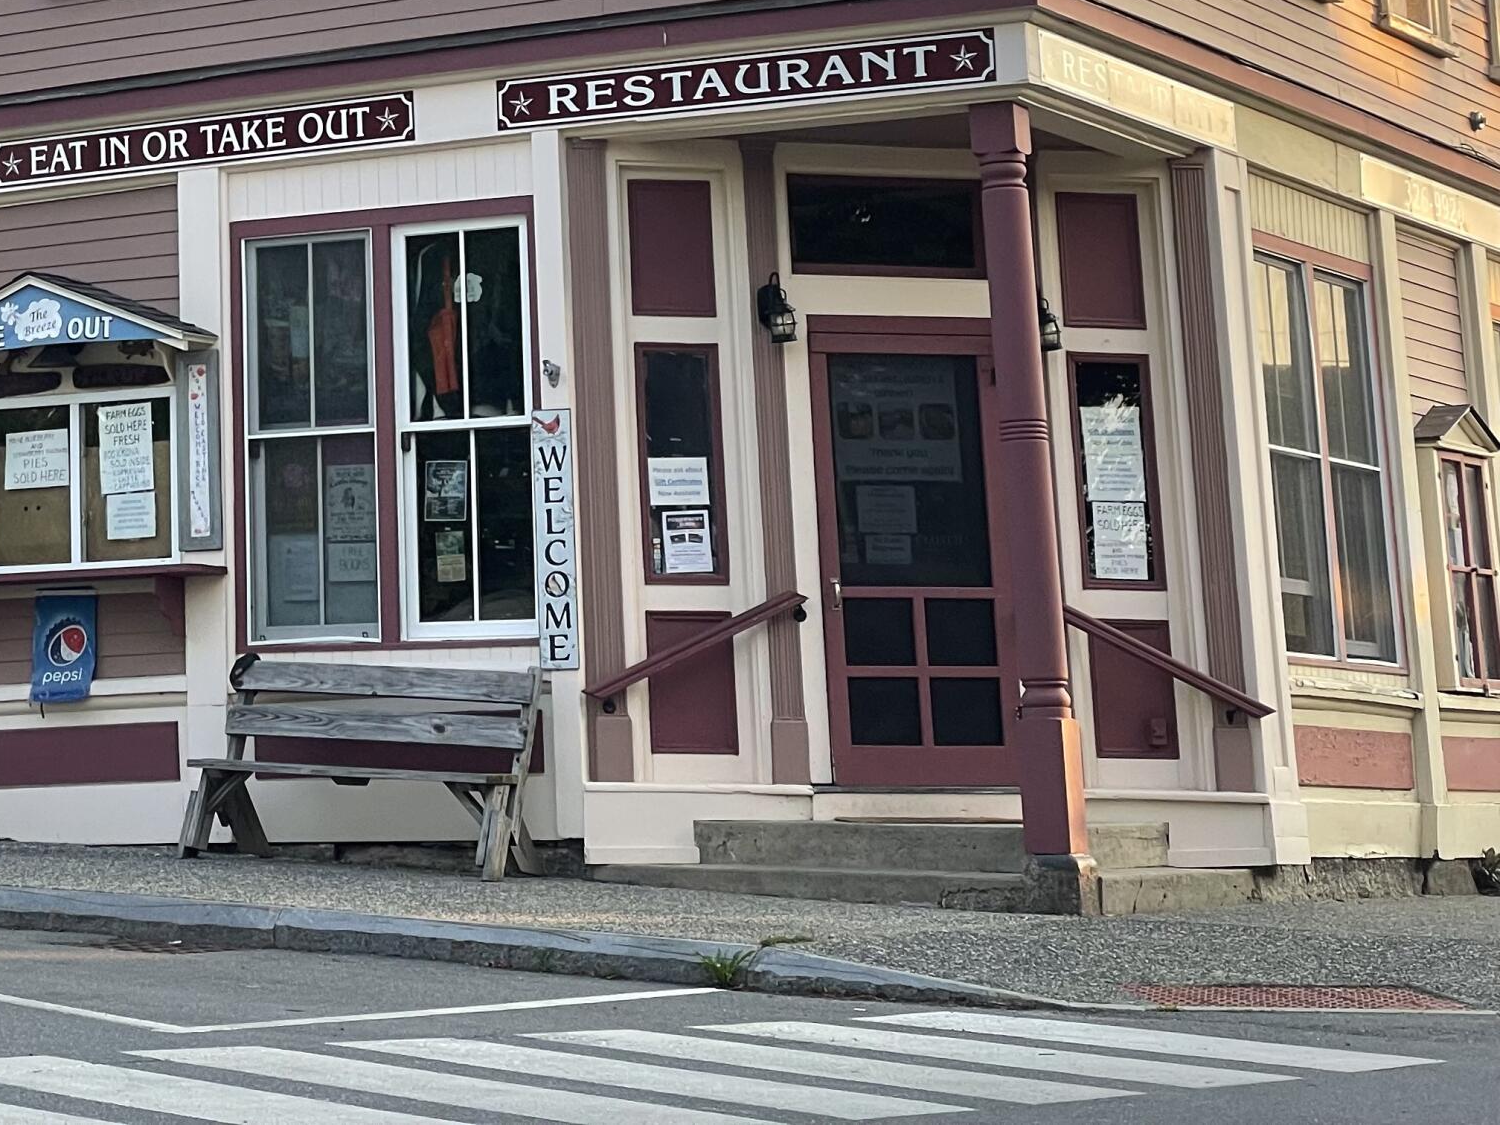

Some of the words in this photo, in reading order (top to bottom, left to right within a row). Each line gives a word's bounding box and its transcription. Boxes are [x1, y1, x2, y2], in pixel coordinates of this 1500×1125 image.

[547, 43, 938, 116] RESTAURANT
[29, 140, 88, 176] EAT
[99, 135, 131, 168] IN
[142, 130, 189, 162] OR
[200, 116, 287, 156] TAKE
[298, 106, 371, 144] OUT
[29, 307, 48, 323] The
[24, 318, 57, 337] Breeze
[67, 316, 113, 340] OUT
[105, 408, 127, 421] FARM
[127, 406, 146, 418] EGGS
[104, 422, 125, 434] SOLD
[126, 419, 148, 431] HERE
[113, 434, 140, 446] FRESH
[22, 456, 49, 469] PIES
[13, 471, 38, 485] SOLD
[40, 468, 67, 483] HERE
[1097, 505, 1120, 515] FARM
[1122, 505, 1143, 517] EGGS
[1097, 519, 1120, 531] SOLD
[538, 444, 572, 662] WELCOME
[42, 667, 83, 686] pepsi
